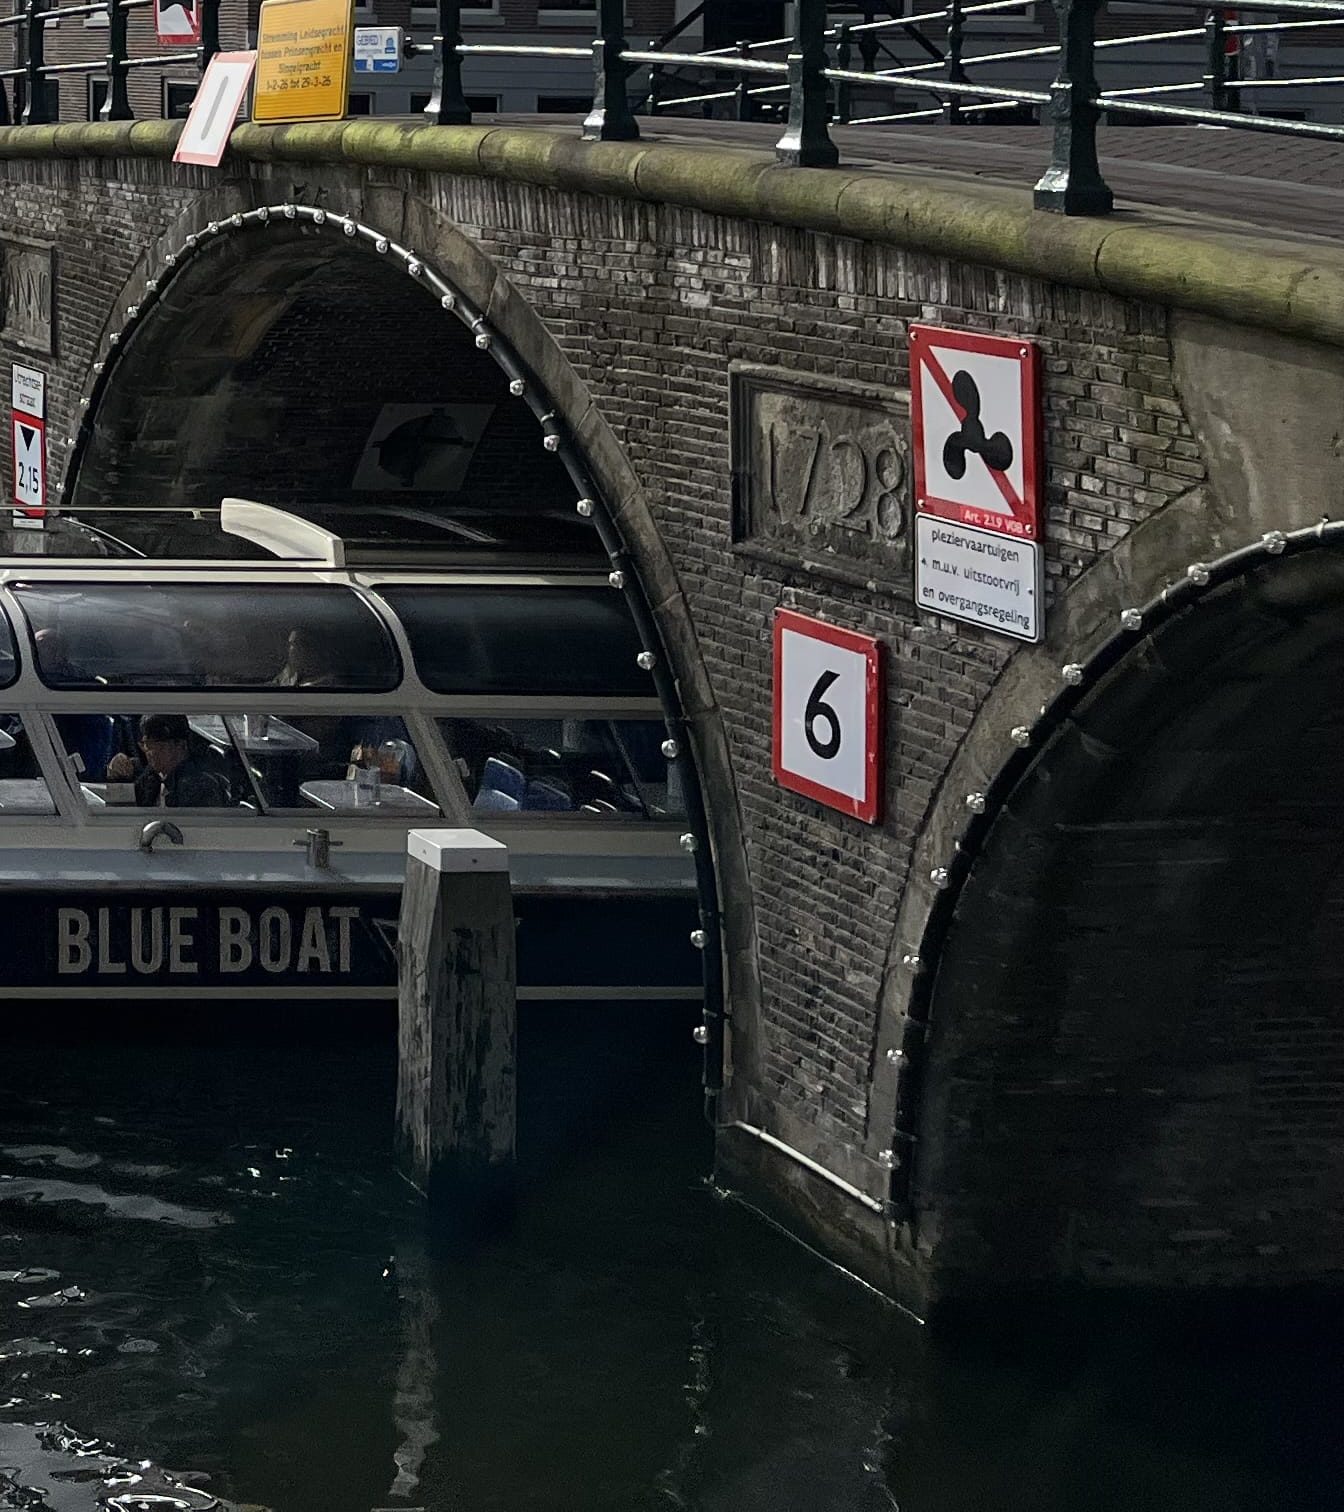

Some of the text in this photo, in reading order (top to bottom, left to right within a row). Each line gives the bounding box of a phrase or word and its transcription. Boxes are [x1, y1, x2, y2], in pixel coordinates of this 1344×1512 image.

[767, 420, 907, 541] 1728
[964, 509, 981, 524] Art.
[931, 529, 1019, 563] pleziervaartuigen
[932, 559, 1021, 596] m.u.v. uitstootvrij
[922, 586, 1030, 630] en overgangsregeling
[804, 669, 842, 760] 6
[57, 905, 360, 974] BLUE BOAT
